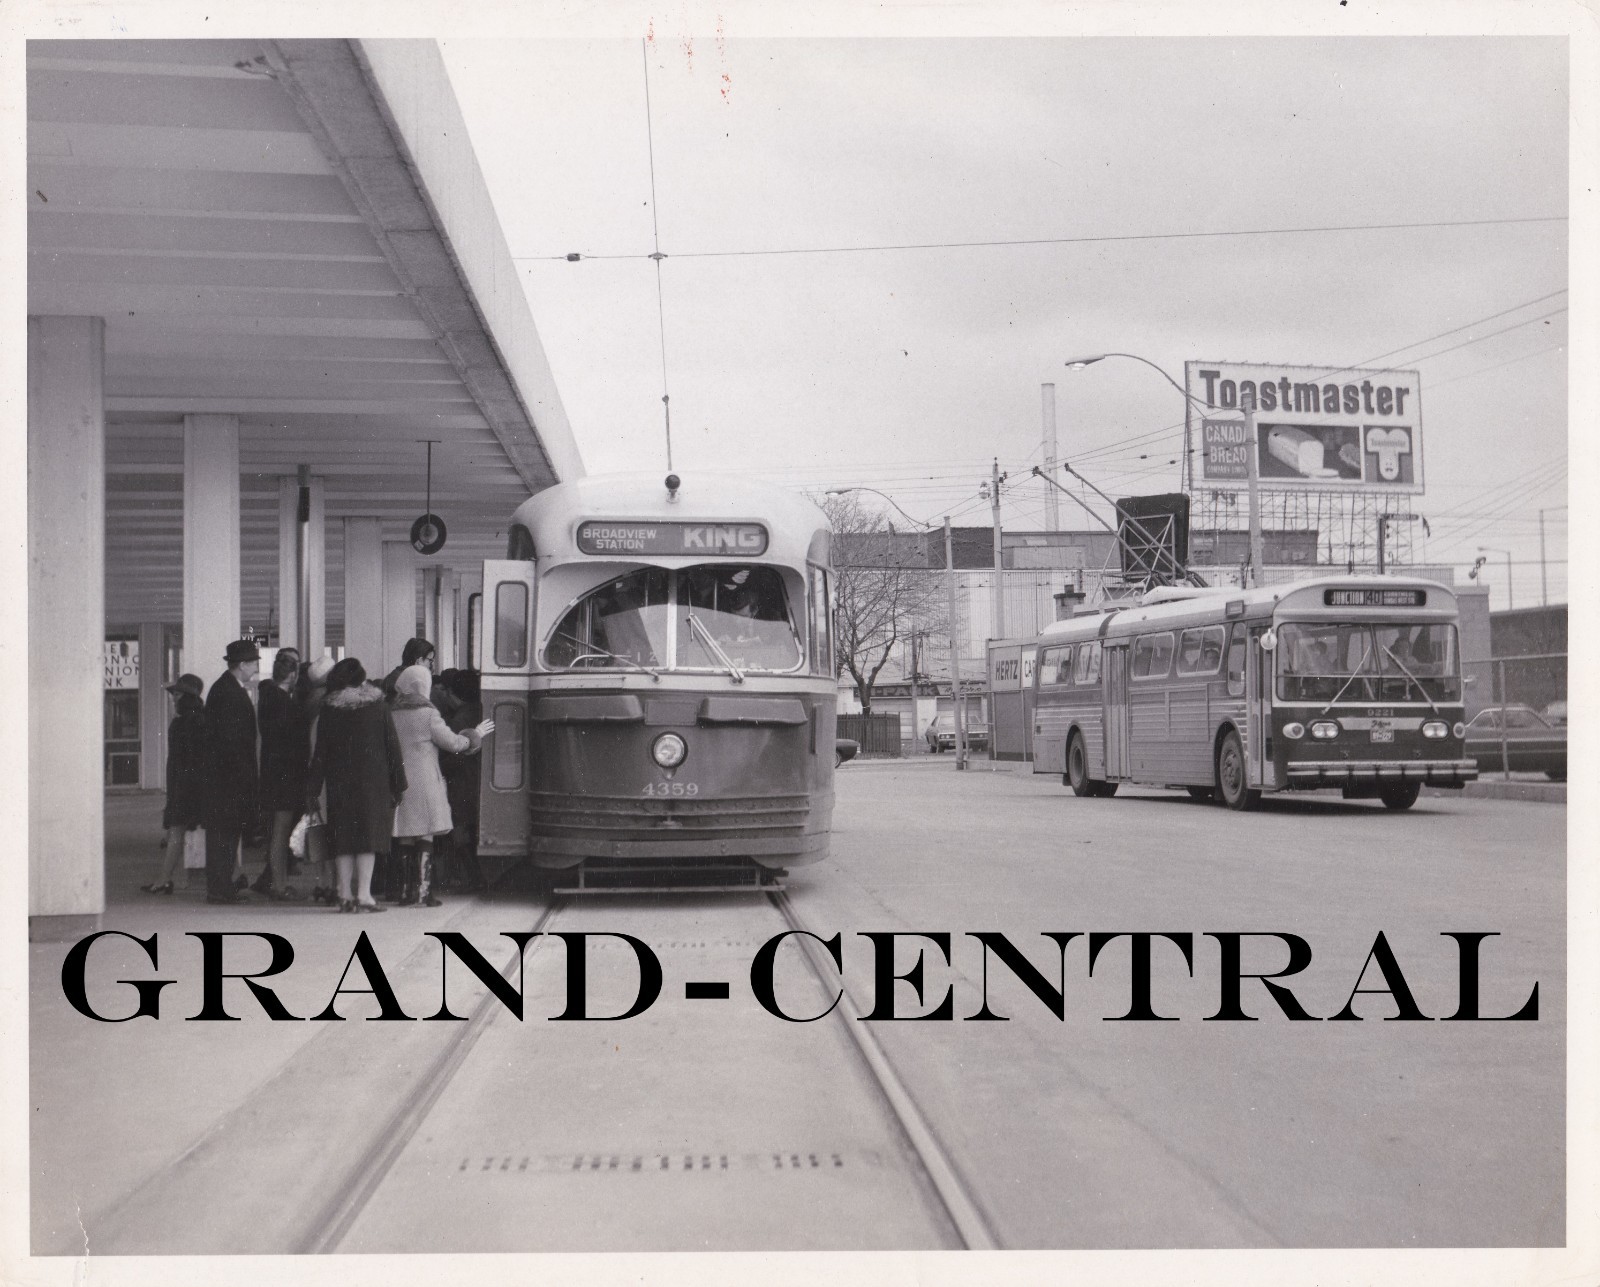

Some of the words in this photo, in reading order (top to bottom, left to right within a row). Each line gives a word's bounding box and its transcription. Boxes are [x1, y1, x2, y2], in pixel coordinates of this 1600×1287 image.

[1199, 369, 1410, 416] Toastmaster
[1210, 445, 1247, 464] BREAD
[582, 528, 657, 540] BROADVIEW
[596, 538, 644, 549] STATION
[683, 527, 761, 548] KING
[995, 659, 1019, 681] HERTZ
[642, 782, 699, 796] 4359
